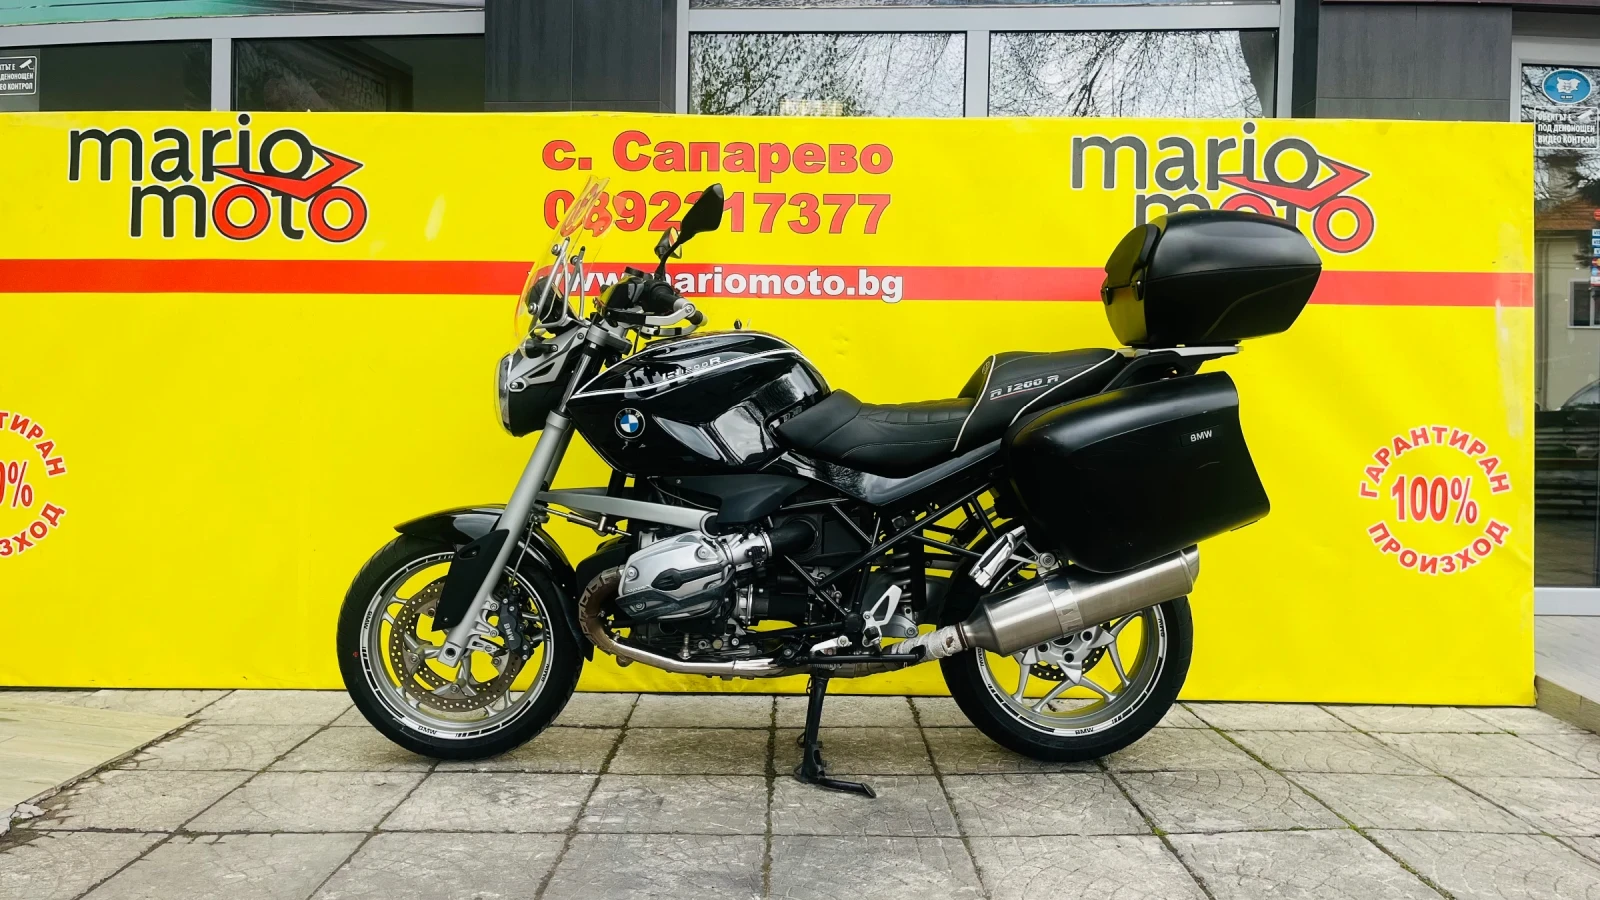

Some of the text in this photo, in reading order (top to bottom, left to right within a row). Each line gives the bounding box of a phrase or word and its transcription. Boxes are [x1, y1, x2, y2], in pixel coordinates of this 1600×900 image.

[68, 113, 314, 183] mario
[541, 129, 894, 183] с. Сапарево
[1070, 121, 1320, 191] mario
[130, 183, 367, 242] moto
[1007, 378, 1043, 393] 1200
[1190, 429, 1213, 442] BMW
[1360, 426, 1510, 498] ГАРАНТИРАН
[1391, 475, 1478, 524] 100%
[1368, 520, 1510, 574] ПРОИЗХОД
[503, 622, 515, 641] BMW
